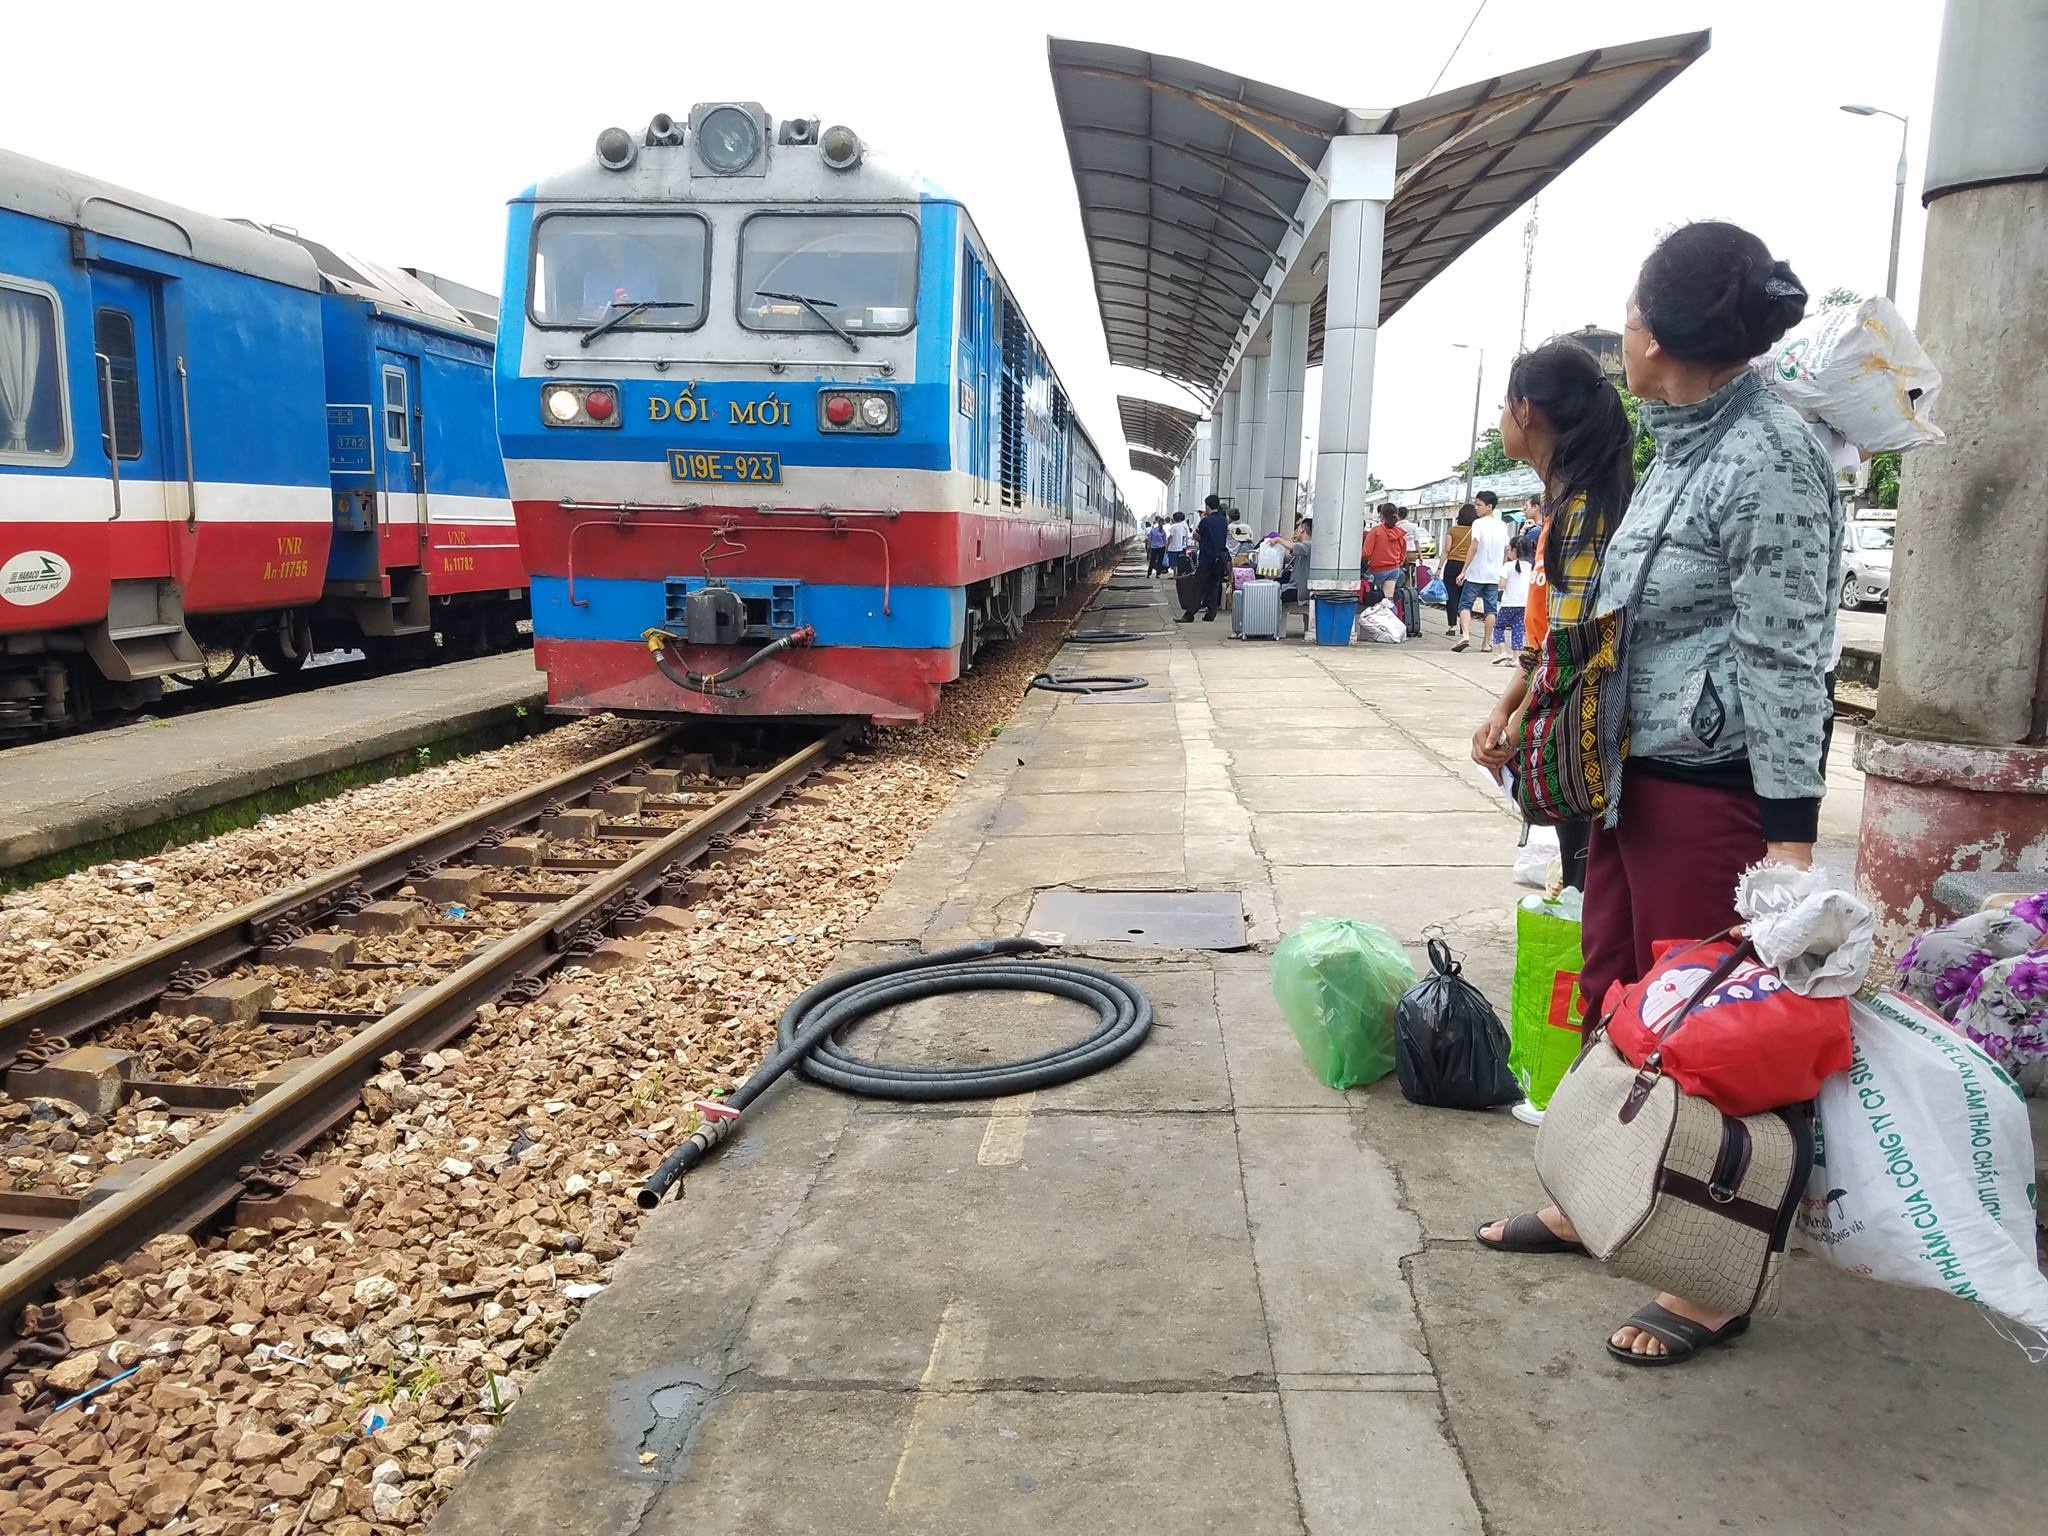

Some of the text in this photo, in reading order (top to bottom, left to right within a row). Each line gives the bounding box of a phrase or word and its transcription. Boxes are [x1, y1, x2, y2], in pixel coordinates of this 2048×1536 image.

[647, 379, 791, 426] ĐỔI MỚI
[338, 437, 366, 449] 1782
[674, 454, 775, 481] D19E-923
[277, 536, 303, 556] VNR
[447, 530, 467, 545] VNR
[1857, 1087, 1887, 1110] CP
[1963, 1081, 1988, 1111] LÂM
[1868, 1112, 1896, 1135] TY
[1969, 1111, 1992, 1149] THAO
[1878, 1133, 1920, 1189] CÔNG
[1972, 1150, 2000, 1185] CHẤT
[1900, 1188, 1939, 1230] CỦA
[1919, 1229, 1967, 1282] PHẨM
